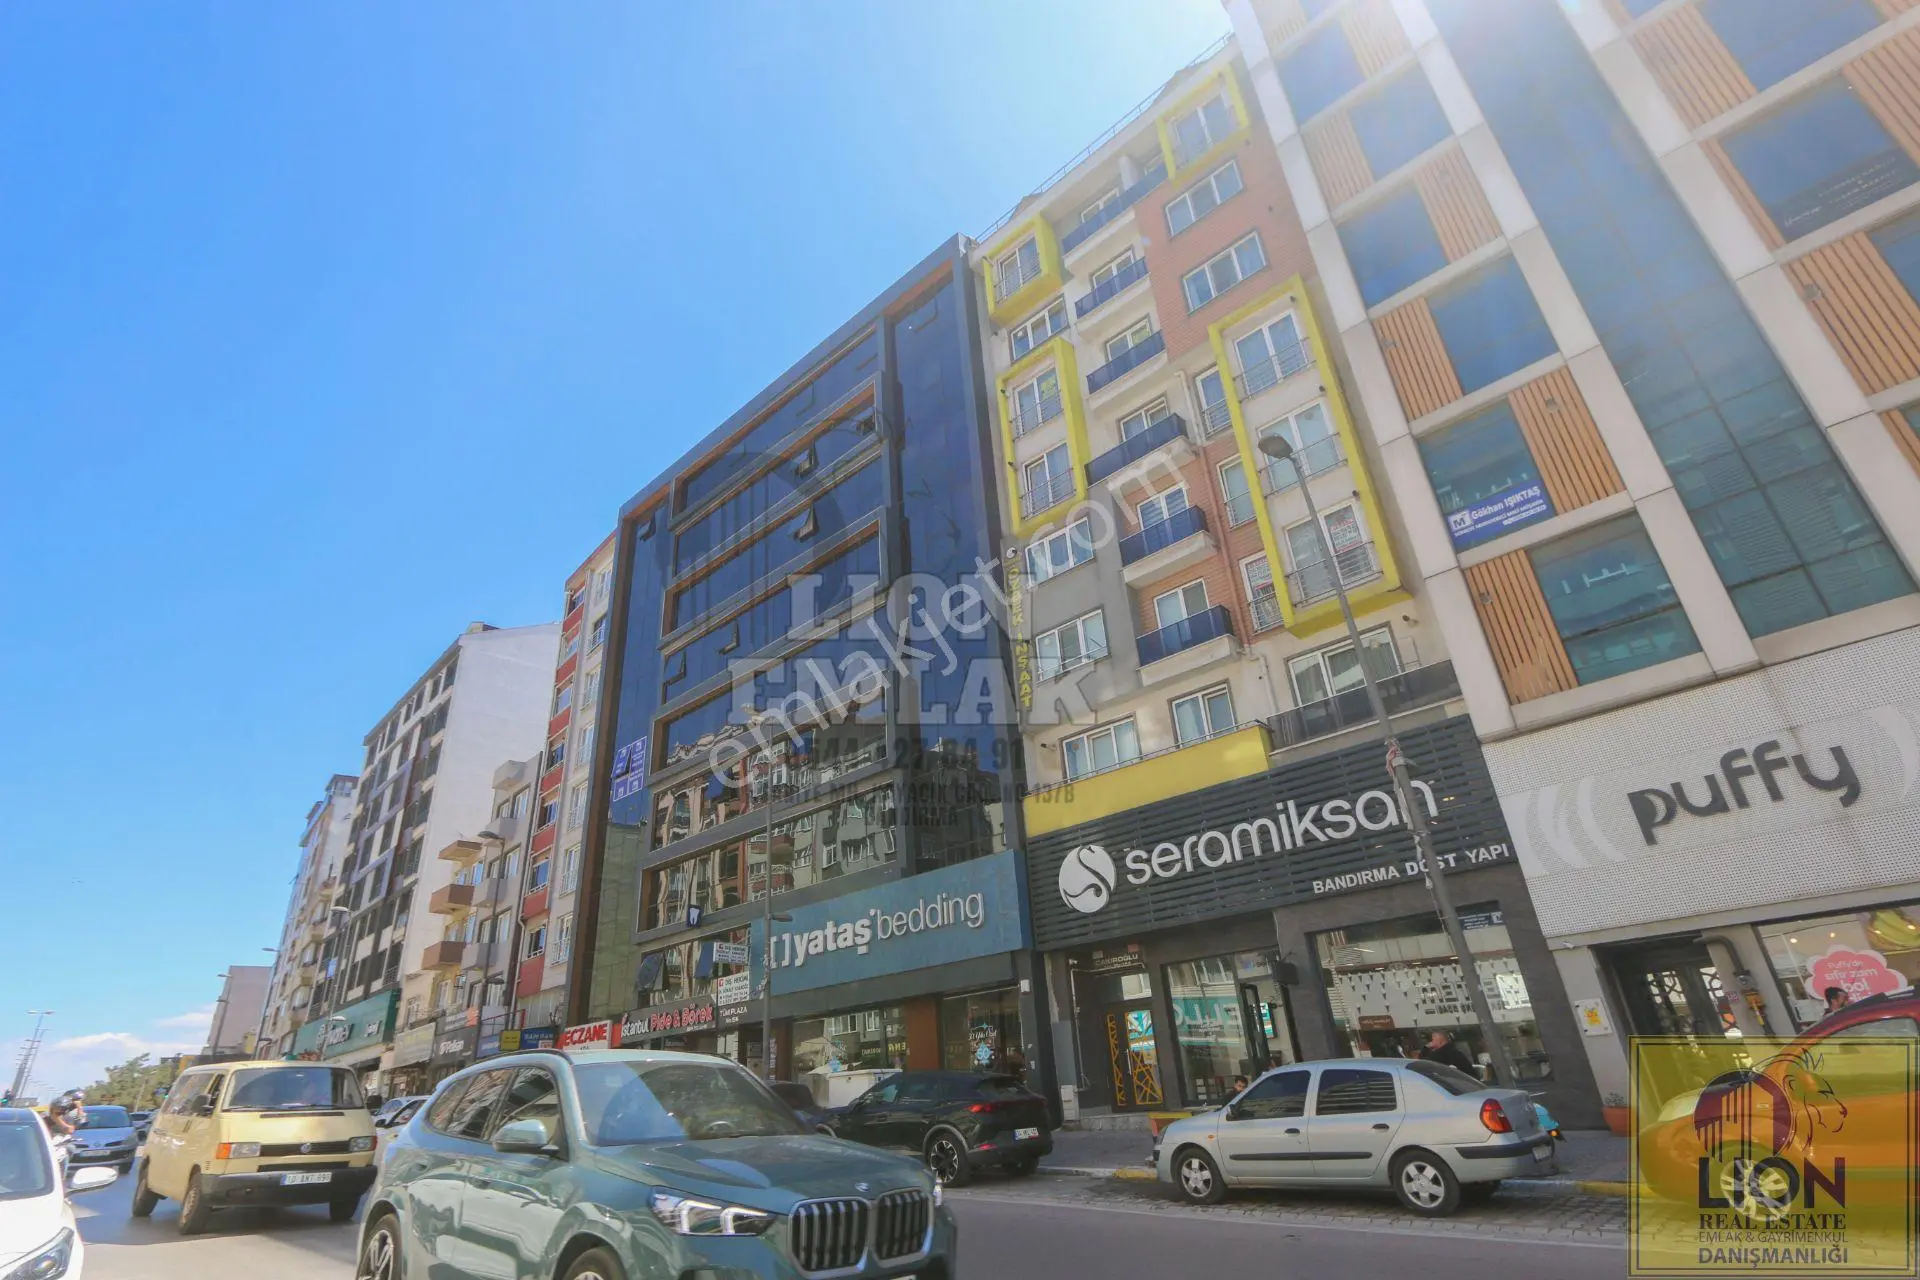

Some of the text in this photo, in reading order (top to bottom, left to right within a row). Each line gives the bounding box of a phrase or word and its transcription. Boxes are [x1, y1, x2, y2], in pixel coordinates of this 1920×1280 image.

[1471, 502, 1504, 519] Gökhan
[1504, 486, 1541, 507] IŞIKTAŞ
[1627, 739, 1861, 846] puffy
[1124, 779, 1439, 886] seramiksan
[1312, 866, 1400, 895] BANDIRMA
[1464, 843, 1510, 865] YAPI
[793, 892, 985, 968] yataş bedding
[564, 1023, 608, 1046] ECZANE
[673, 1009, 681, 1027] &
